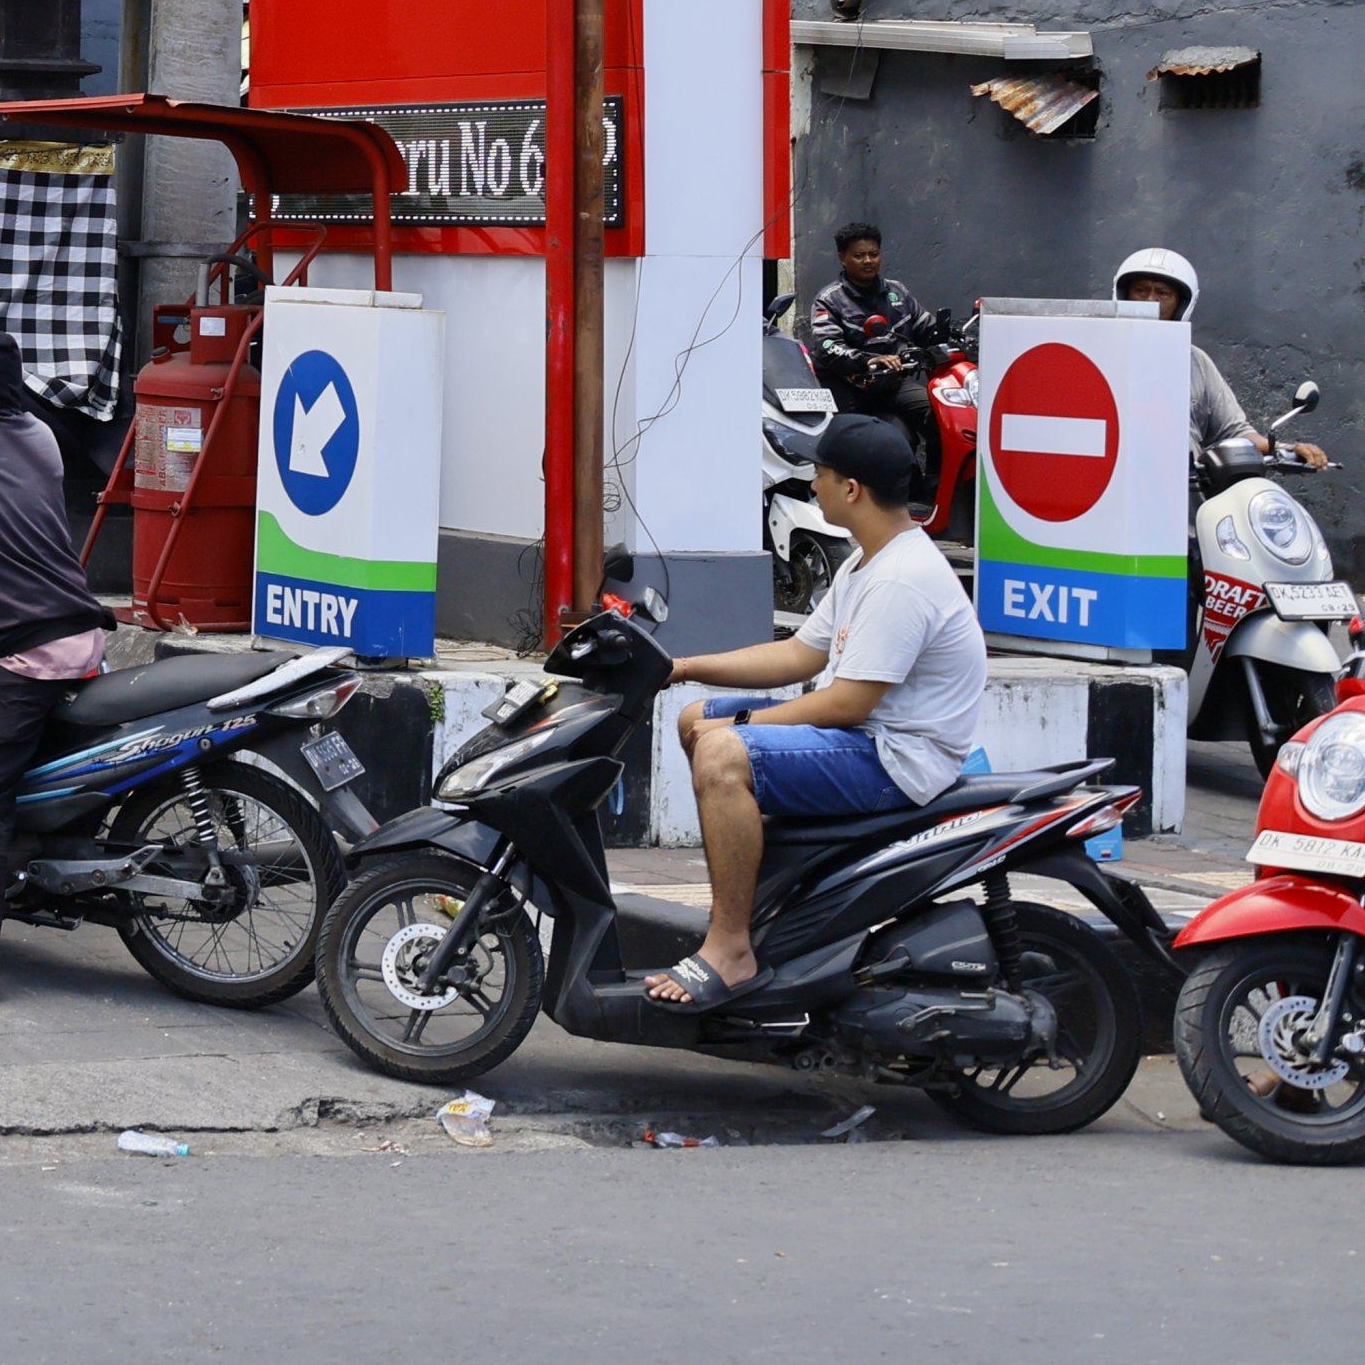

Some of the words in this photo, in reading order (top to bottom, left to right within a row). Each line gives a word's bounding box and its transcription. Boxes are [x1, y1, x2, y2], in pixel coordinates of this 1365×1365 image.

[457, 121, 511, 196] No
[266, 583, 358, 637] ENTRY
[1003, 578, 1098, 627] EXIT
[1204, 575, 1267, 608] DRAFT
[1205, 595, 1247, 619] BEER
[1271, 586, 1290, 599] DK
[119, 724, 221, 756] Shogun
[221, 713, 258, 732] 125
[1259, 833, 1282, 847] DK
[1292, 838, 1336, 854] 5812
[1341, 843, 1365, 858] KA
